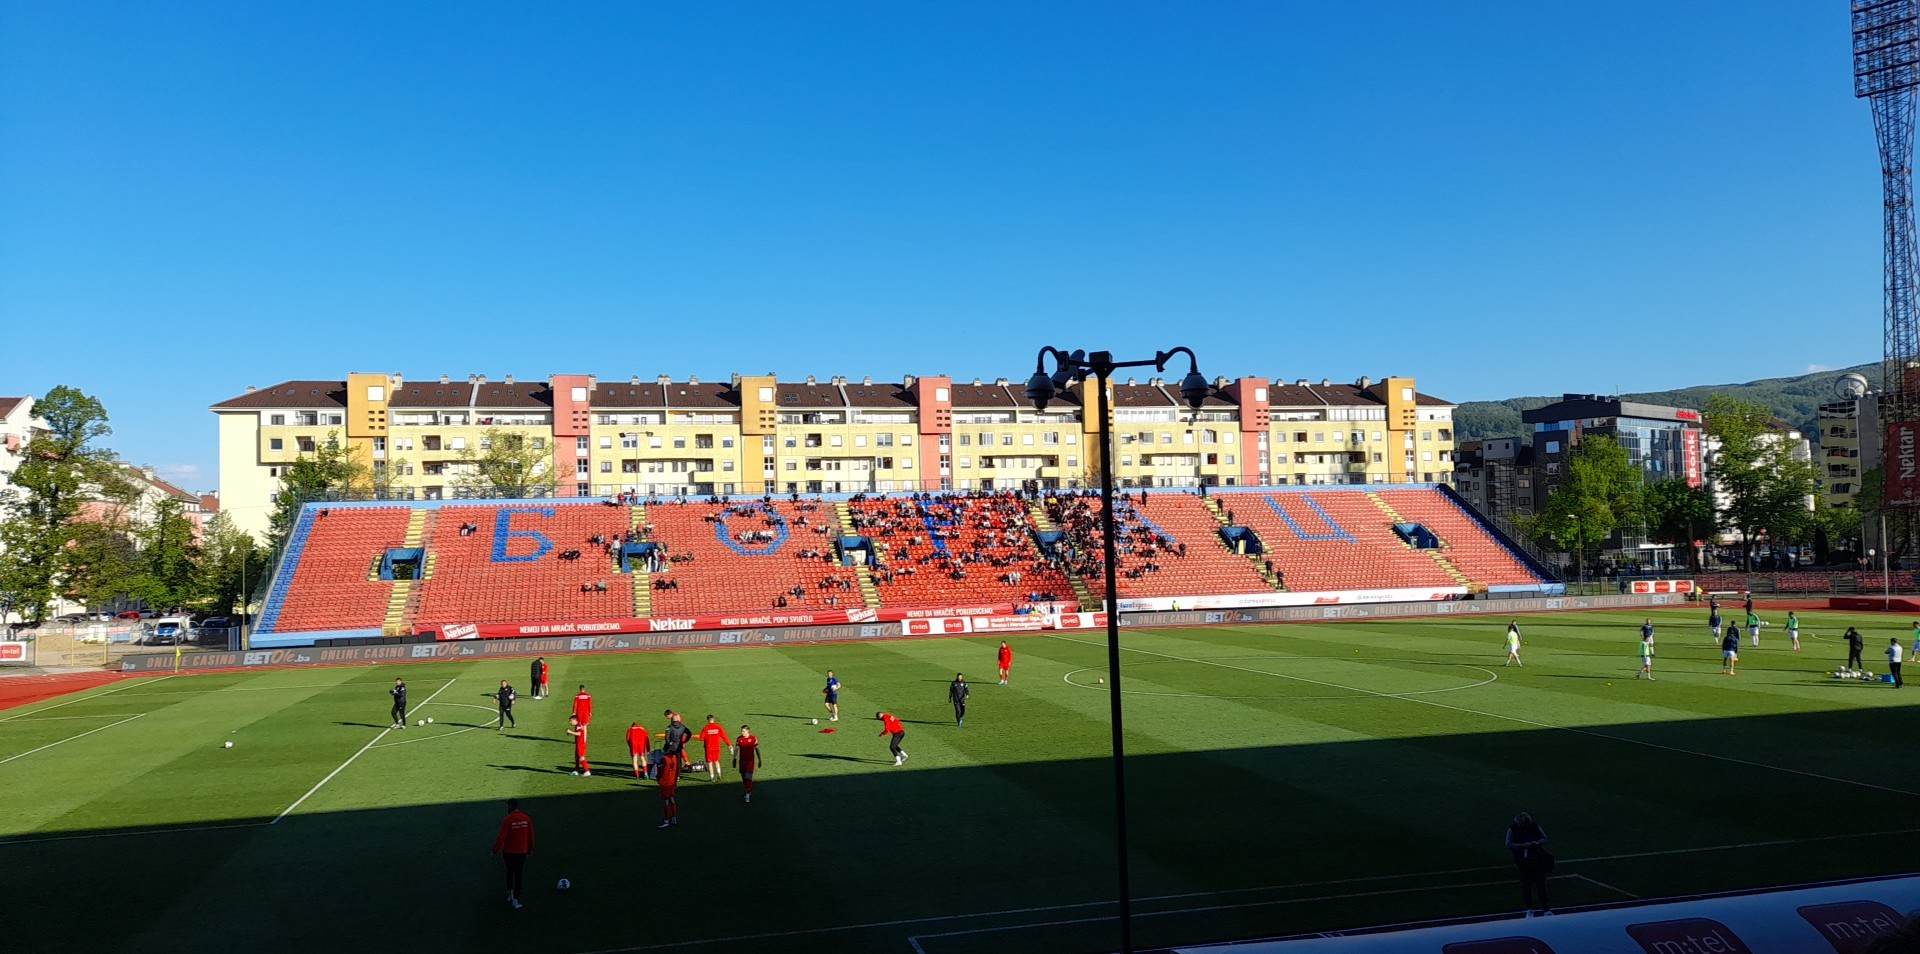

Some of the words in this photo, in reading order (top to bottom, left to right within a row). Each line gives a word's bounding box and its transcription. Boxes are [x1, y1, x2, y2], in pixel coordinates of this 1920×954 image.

[1898, 427, 1916, 480] Nektar
[649, 618, 696, 631] Nektar
[1138, 614, 1168, 625] ONLINE
[1170, 613, 1200, 624] CASINO
[1259, 609, 1287, 620] ONLINE
[192, 655, 236, 667] CASINO
[243, 650, 310, 666] BETOle.ba
[320, 648, 359, 661] ONLINE
[364, 646, 404, 659] CASINO
[411, 643, 474, 658] BETOle.ba
[484, 641, 520, 653] ONLINE
[525, 639, 564, 652] CASINO
[569, 635, 630, 651] BETOle.ba
[638, 633, 673, 646] ONLINE
[677, 632, 713, 645] CASINO
[783, 627, 817, 640] ONLINE
[820, 626, 855, 640] CASINO
[1825, 911, 1896, 939] m:tel
